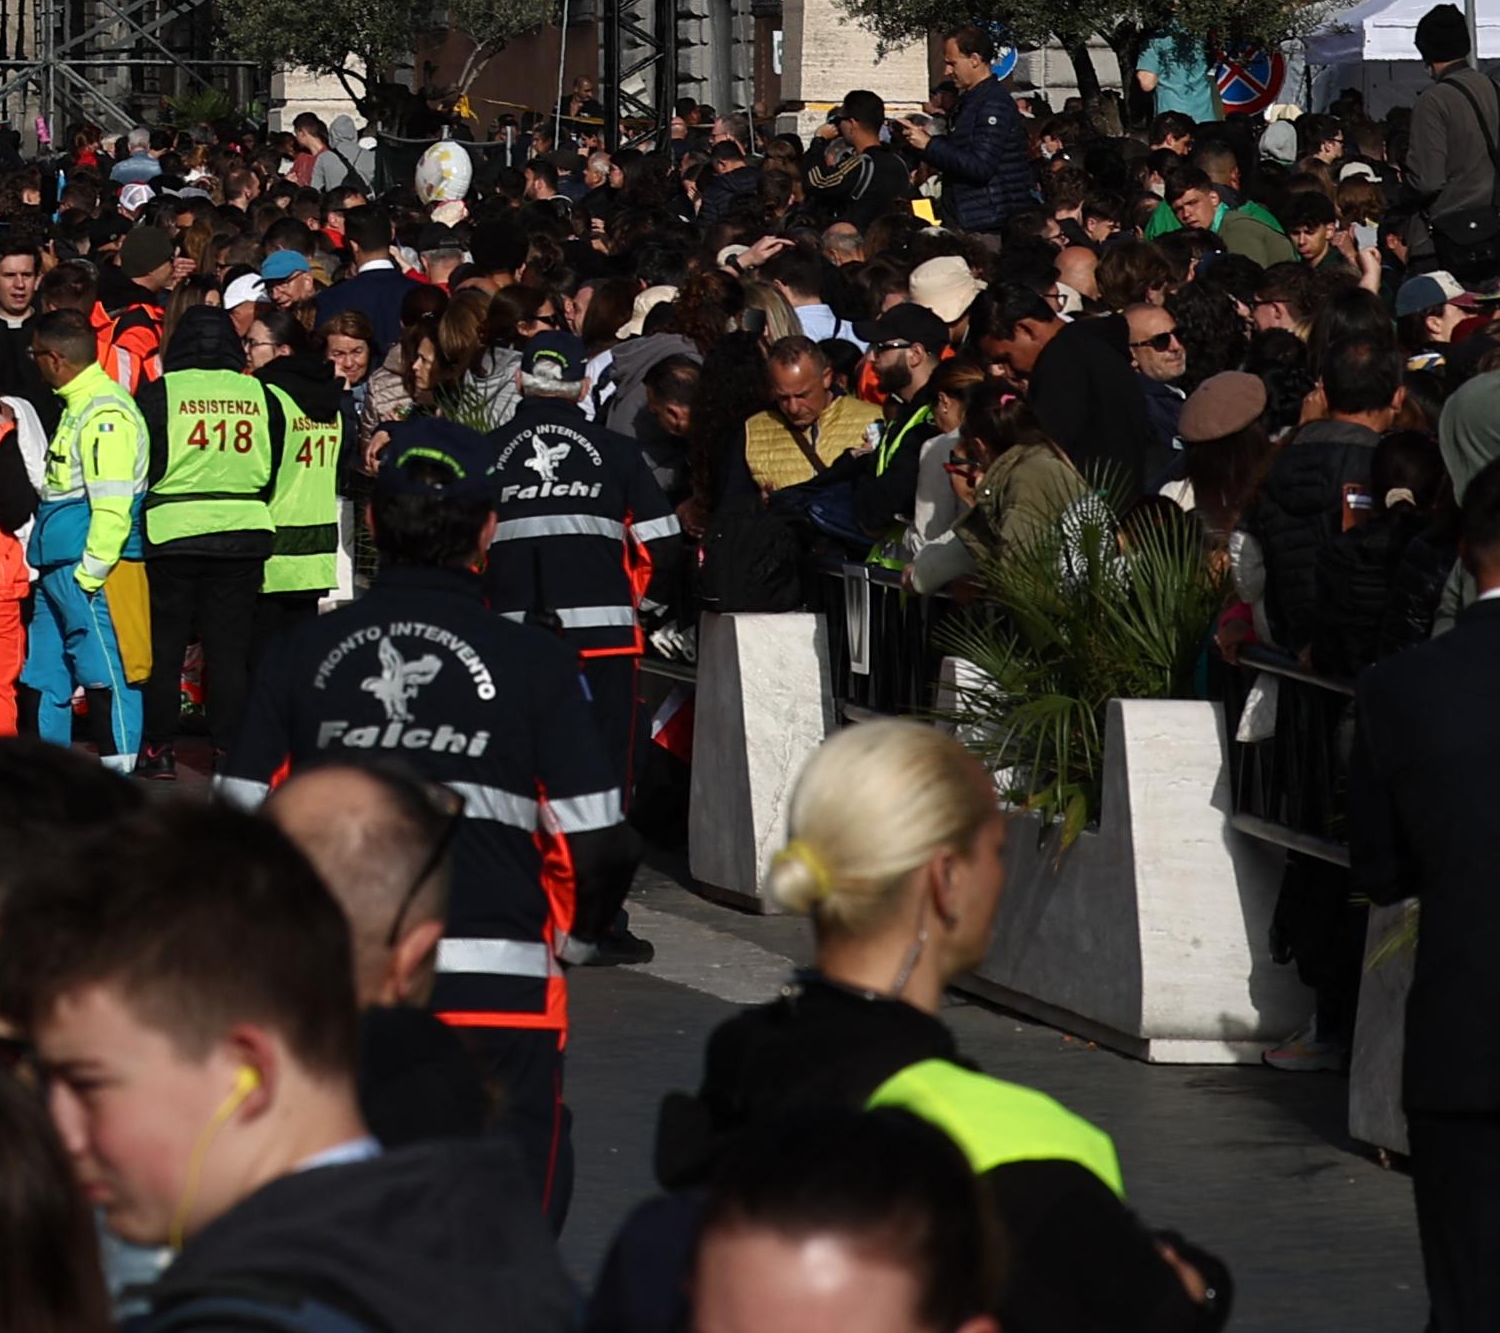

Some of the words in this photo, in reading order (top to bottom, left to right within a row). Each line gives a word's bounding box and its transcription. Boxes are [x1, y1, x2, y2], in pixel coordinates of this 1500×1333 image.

[178, 400, 260, 416] ASSISTENZA
[187, 419, 253, 453] 418
[296, 435, 338, 469] 417
[496, 429, 533, 471] PRONTO
[535, 423, 603, 467] INTERVENTO
[500, 480, 603, 504] Falchi
[314, 625, 382, 690] PRONTO
[389, 621, 497, 701] INTERVENTO
[316, 719, 492, 758] Falchi
